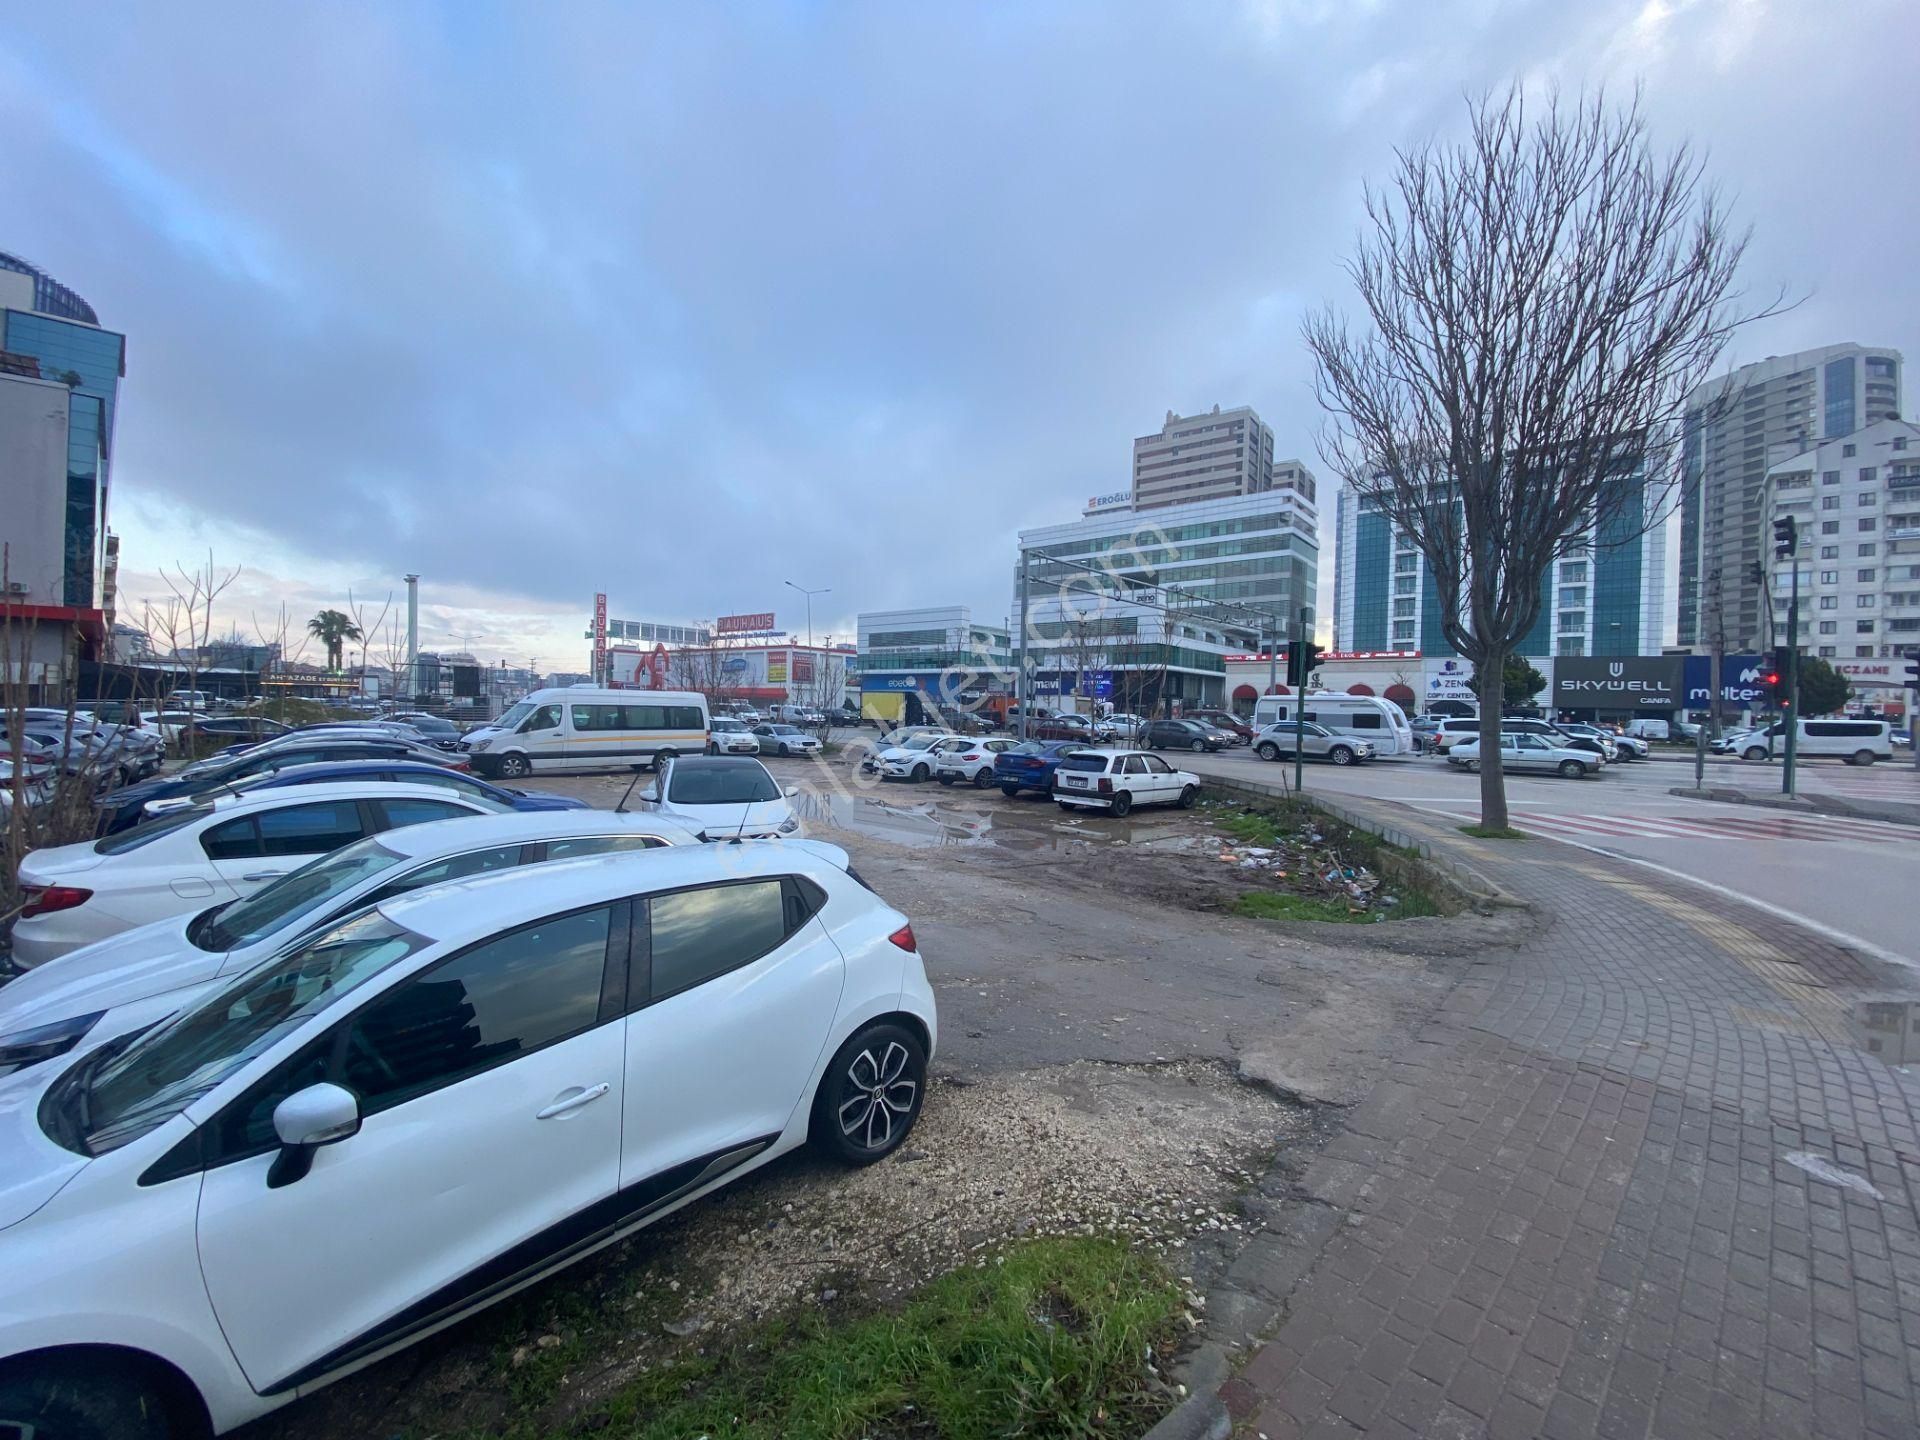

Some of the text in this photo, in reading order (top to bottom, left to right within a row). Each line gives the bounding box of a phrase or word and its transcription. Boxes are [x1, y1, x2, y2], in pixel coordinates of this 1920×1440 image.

[1098, 493, 1131, 506] EROĞLU
[719, 615, 773, 630] BAUHAUS
[1035, 678, 1059, 689] mavi
[1561, 680, 1671, 691] SKYWELL
